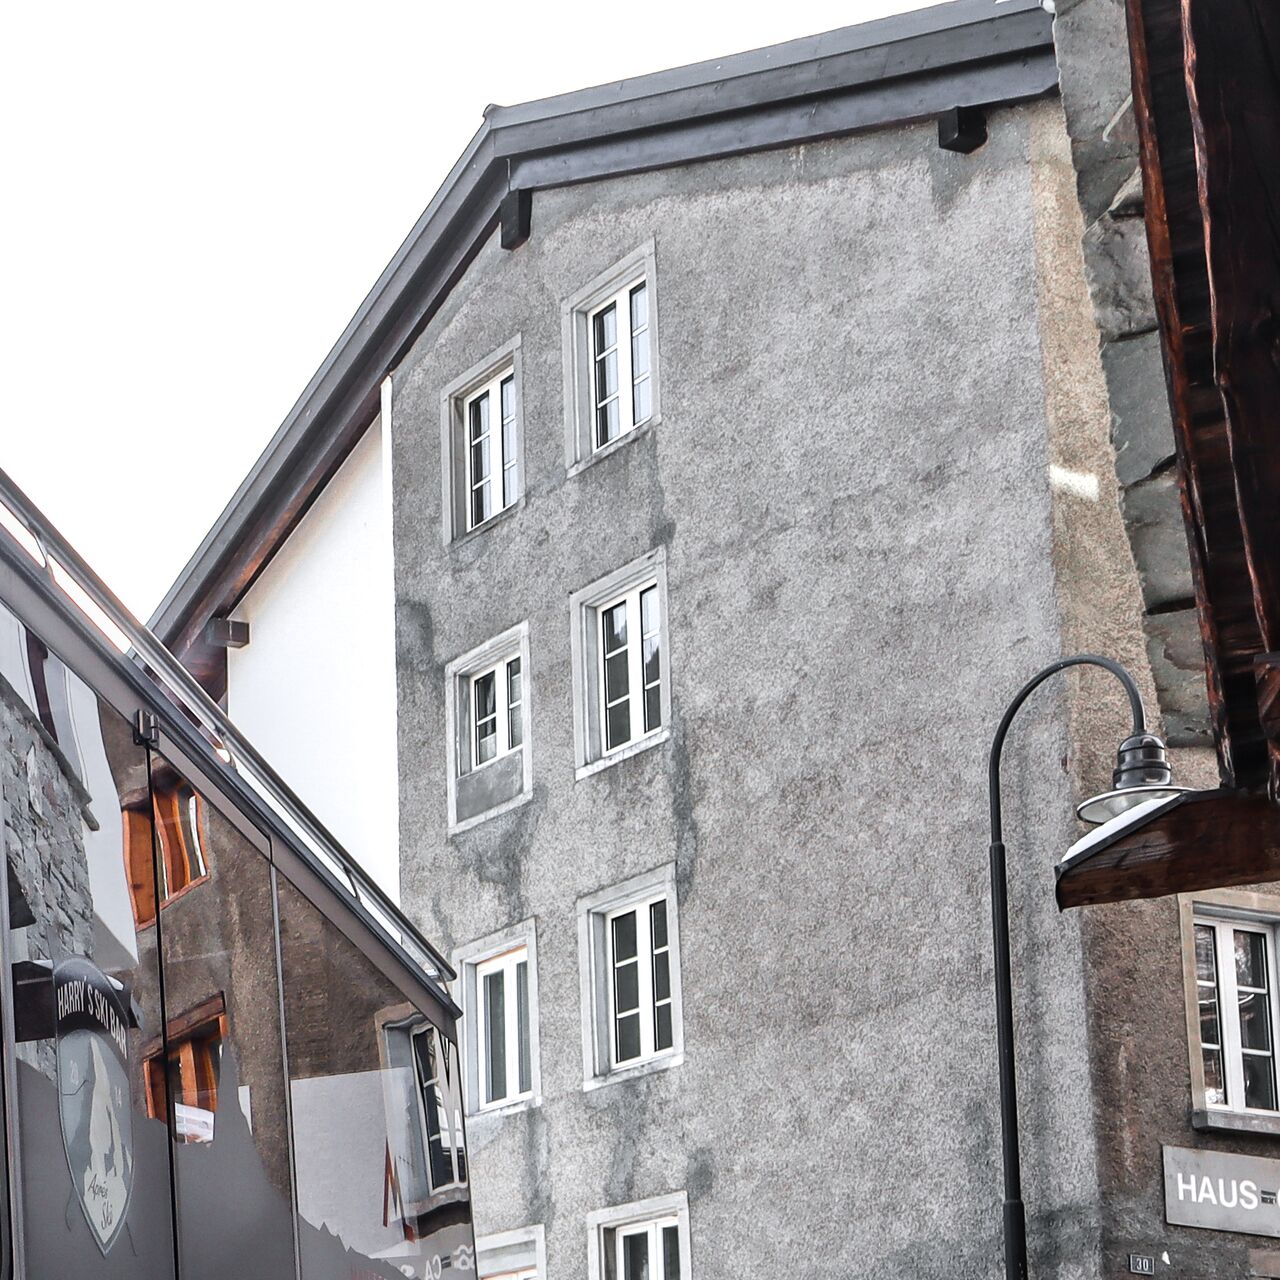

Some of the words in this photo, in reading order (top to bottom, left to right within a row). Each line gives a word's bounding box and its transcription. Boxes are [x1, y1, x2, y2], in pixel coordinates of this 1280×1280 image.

[94, 988, 109, 1031] SKI
[109, 1005, 128, 1060] BAR
[1177, 1172, 1259, 1210] HAUS
[1136, 1257, 1149, 1272] 30
